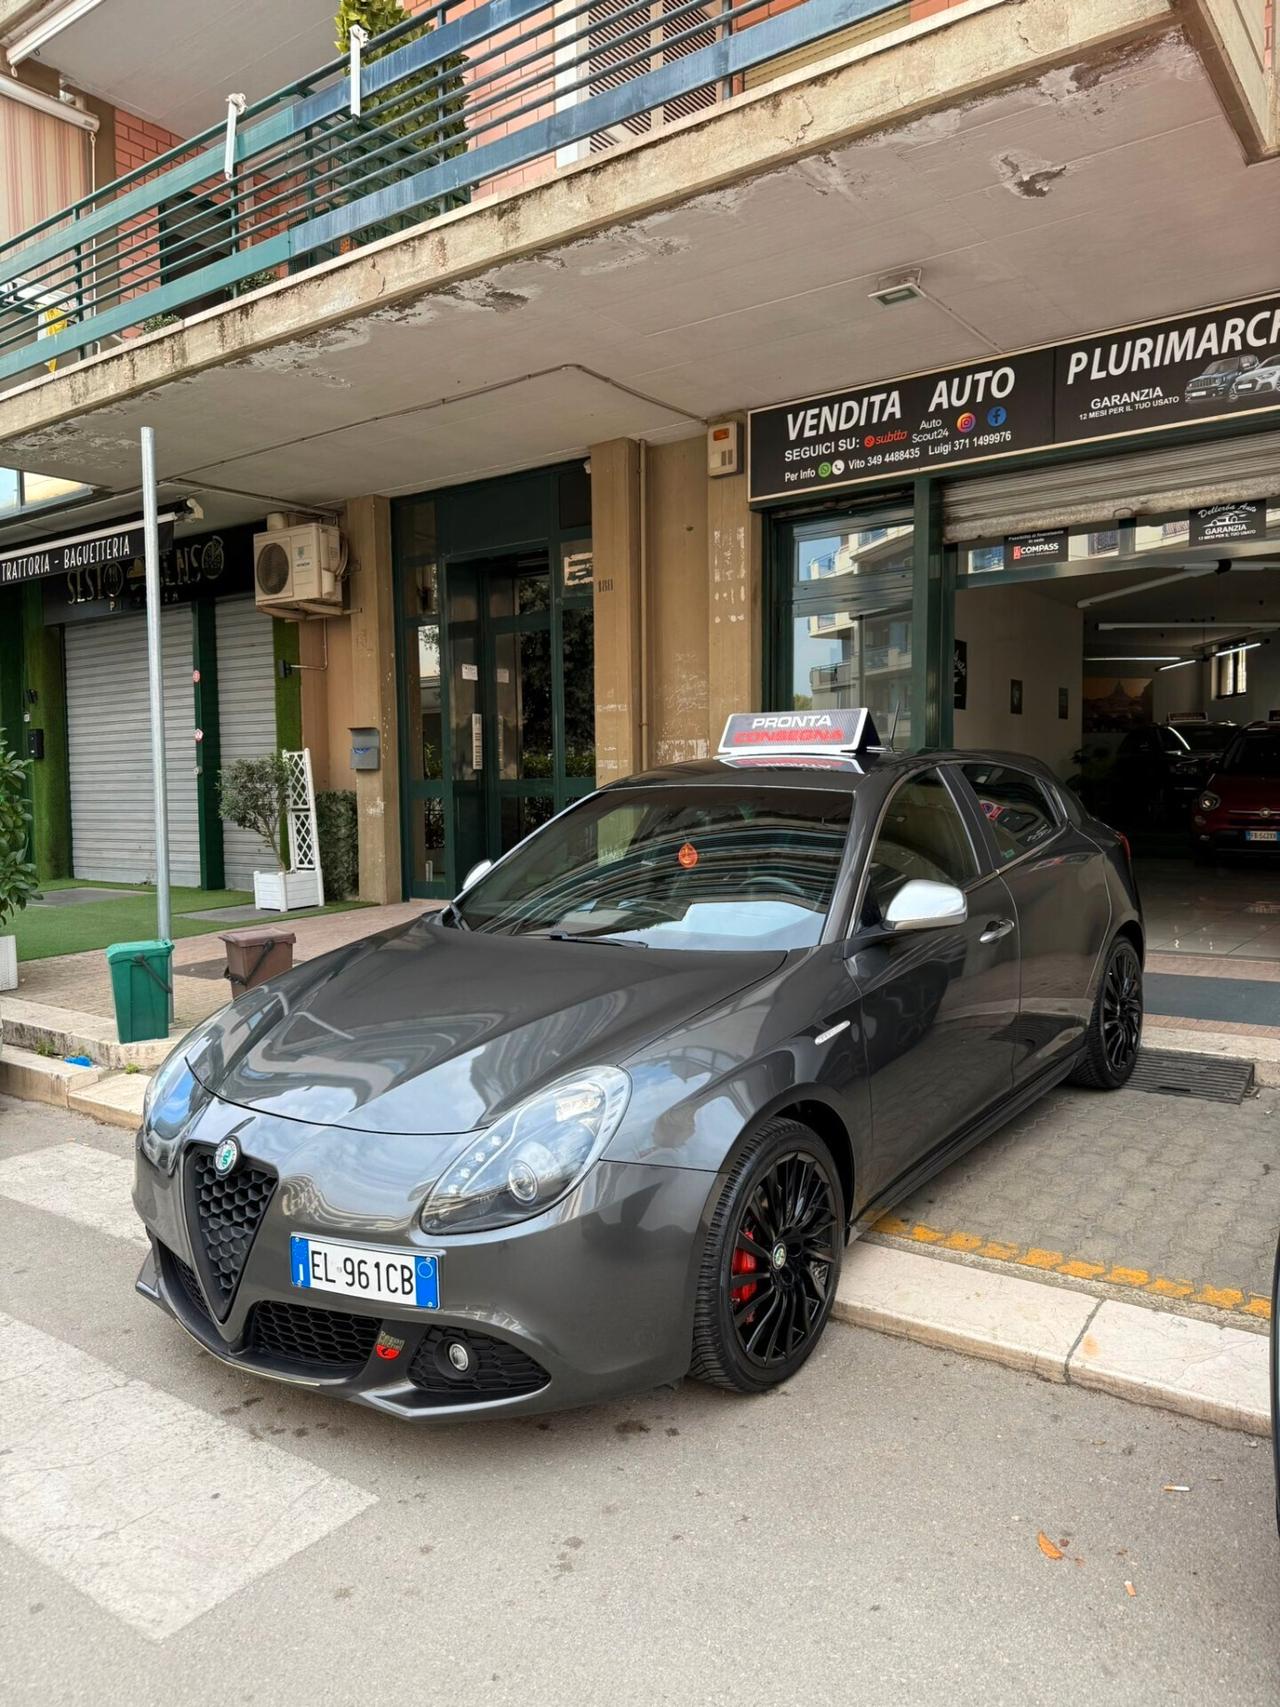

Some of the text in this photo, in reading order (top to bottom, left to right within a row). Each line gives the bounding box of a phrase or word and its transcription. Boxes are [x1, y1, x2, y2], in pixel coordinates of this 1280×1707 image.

[786, 366, 1016, 441] VENDITA AUTO
[1079, 413, 1088, 421] 12
[1088, 408, 1108, 418] MESI
[1108, 405, 1125, 415] PER
[1134, 401, 1151, 410] TUO
[1152, 395, 1180, 407] USATO
[1090, 386, 1164, 410] GARANZIA
[911, 427, 949, 443] Scout24
[919, 419, 942, 430] Auto
[784, 430, 908, 462] SEGUICI SU: subito
[928, 430, 1012, 456] Luigi 371 1499976
[784, 446, 920, 482] Per Info Vito 349 4488435
[1205, 524, 1247, 535] GARANZIA
[2, 553, 50, 582] TRATTORIA
[64, 535, 130, 569] BAGUETTERIA
[1020, 543, 1059, 554] COMPASS
[752, 714, 832, 729] PRONTA
[311, 1250, 414, 1296] EL 961CB
